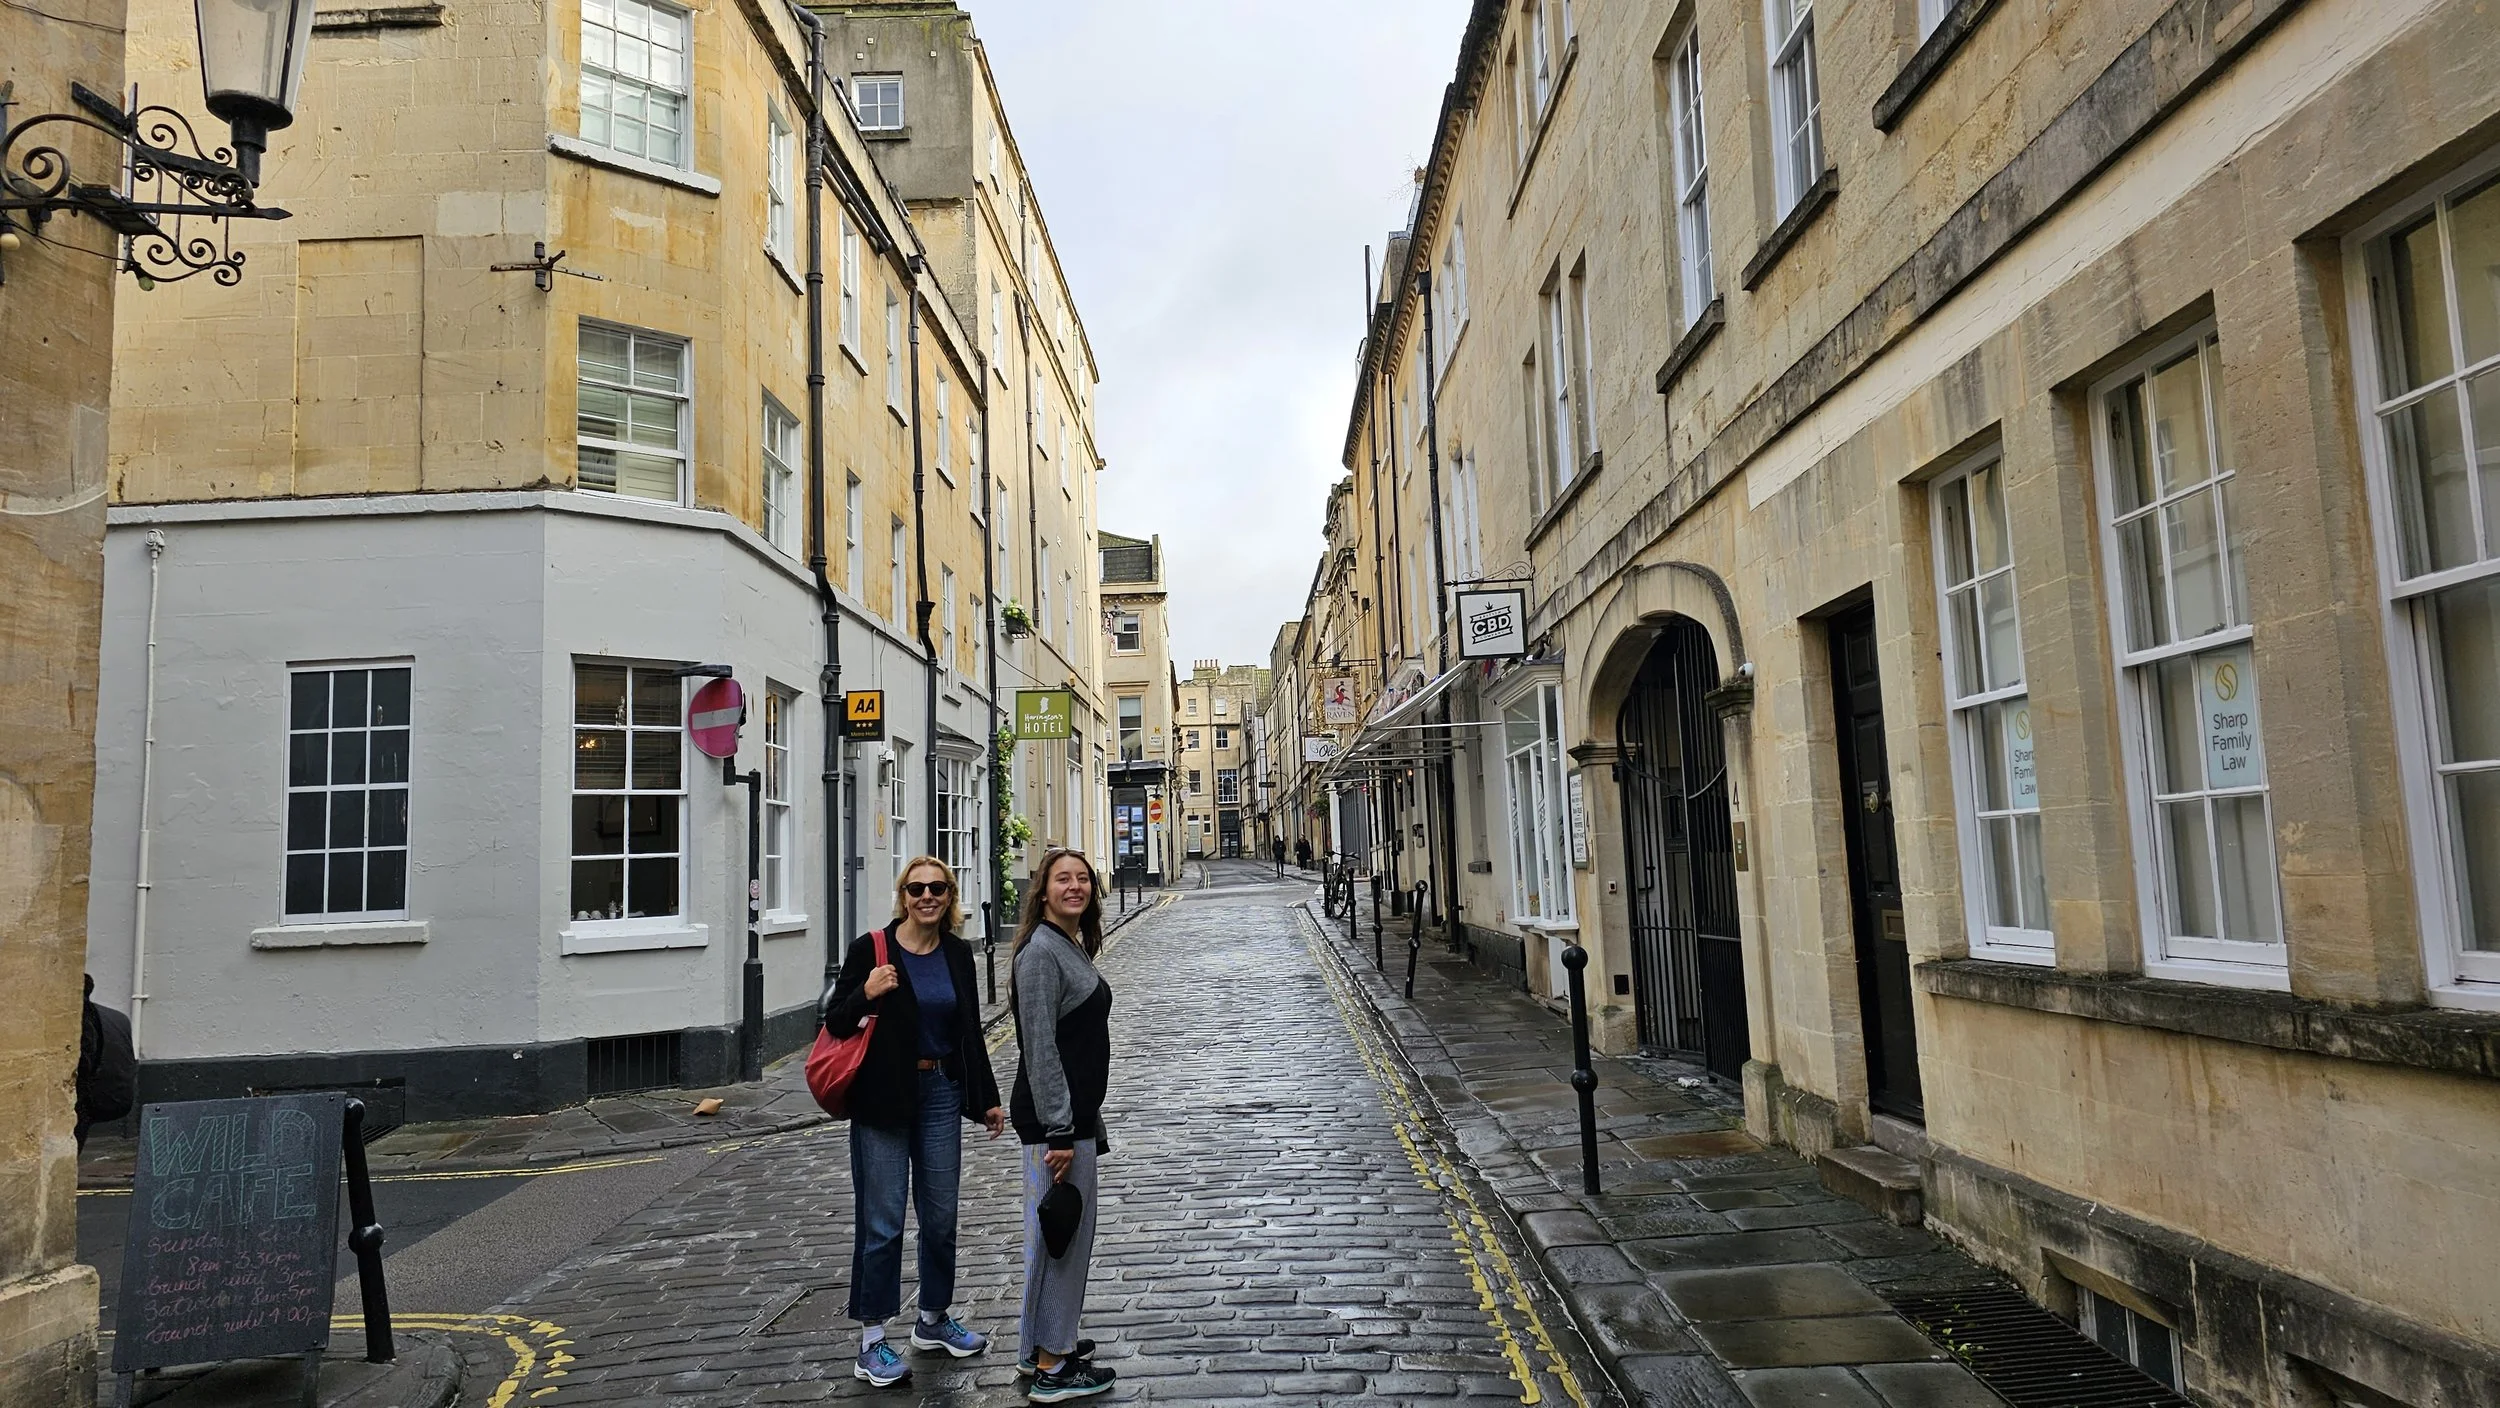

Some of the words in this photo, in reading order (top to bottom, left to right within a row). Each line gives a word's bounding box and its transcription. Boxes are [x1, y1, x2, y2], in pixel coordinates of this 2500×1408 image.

[1473, 615, 1510, 635] CBD
[854, 698, 875, 714] AA
[1326, 710, 1355, 720] RAVEN
[1024, 722, 1064, 733] HOTEL
[2213, 712, 2249, 730] Sharp
[2212, 731, 2252, 751] Family
[2221, 754, 2246, 770] Law
[2014, 764, 2036, 780] Famil
[1732, 781, 1740, 813] 4
[150, 1109, 317, 1177] WILD
[151, 1163, 317, 1230] CAFE
